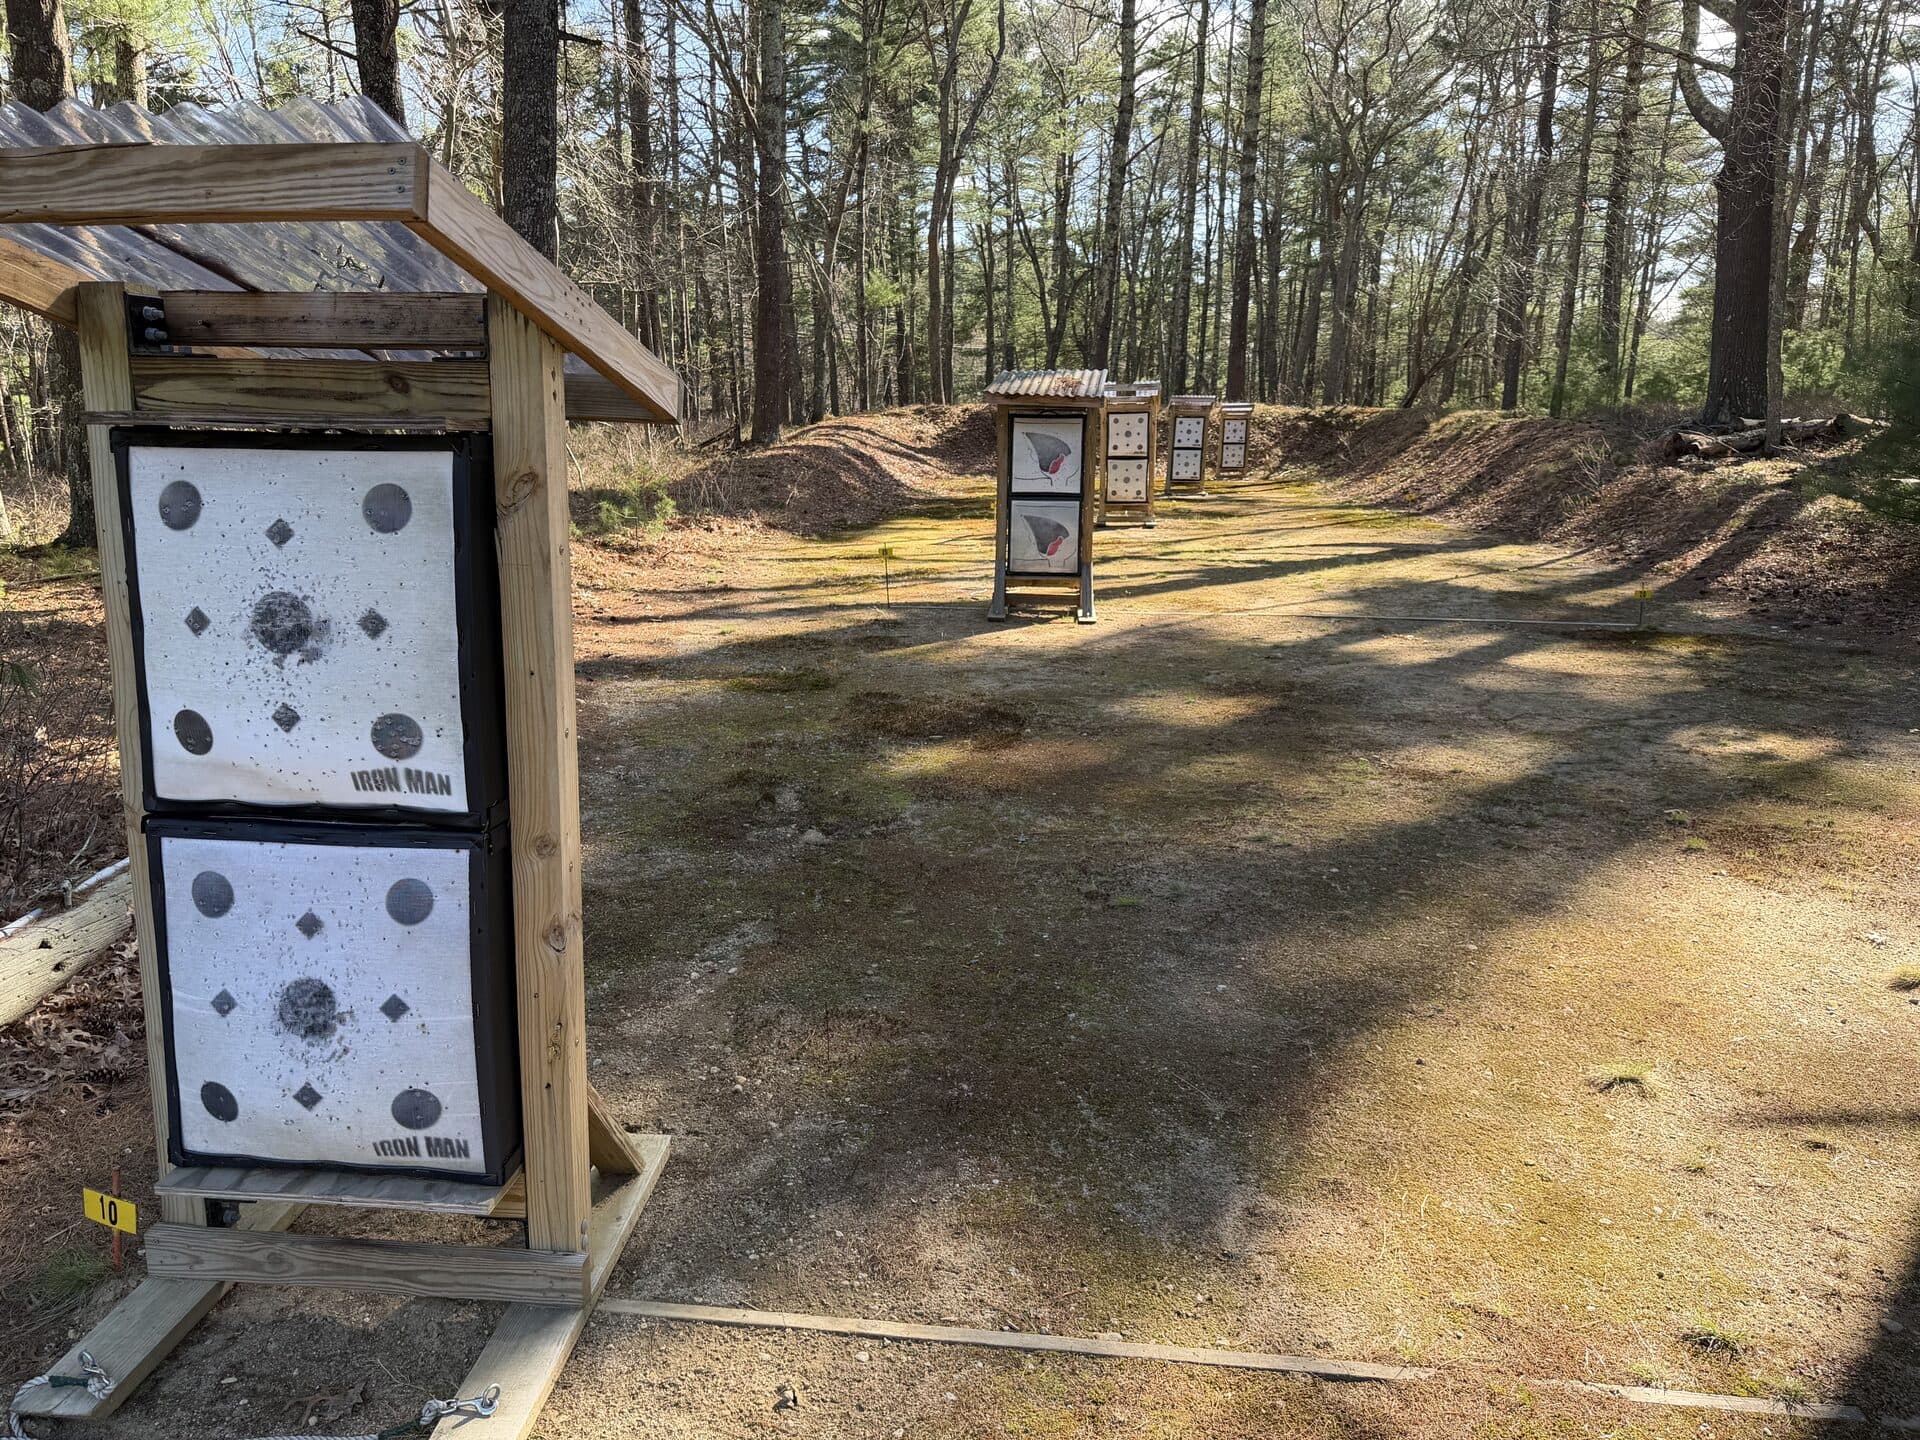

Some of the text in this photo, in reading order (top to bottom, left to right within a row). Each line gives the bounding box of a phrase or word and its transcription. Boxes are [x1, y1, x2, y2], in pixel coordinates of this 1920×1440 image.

[350, 767, 452, 796] IRON MAN
[372, 1136, 470, 1158] IRON MAN
[99, 1195, 118, 1226] 10
